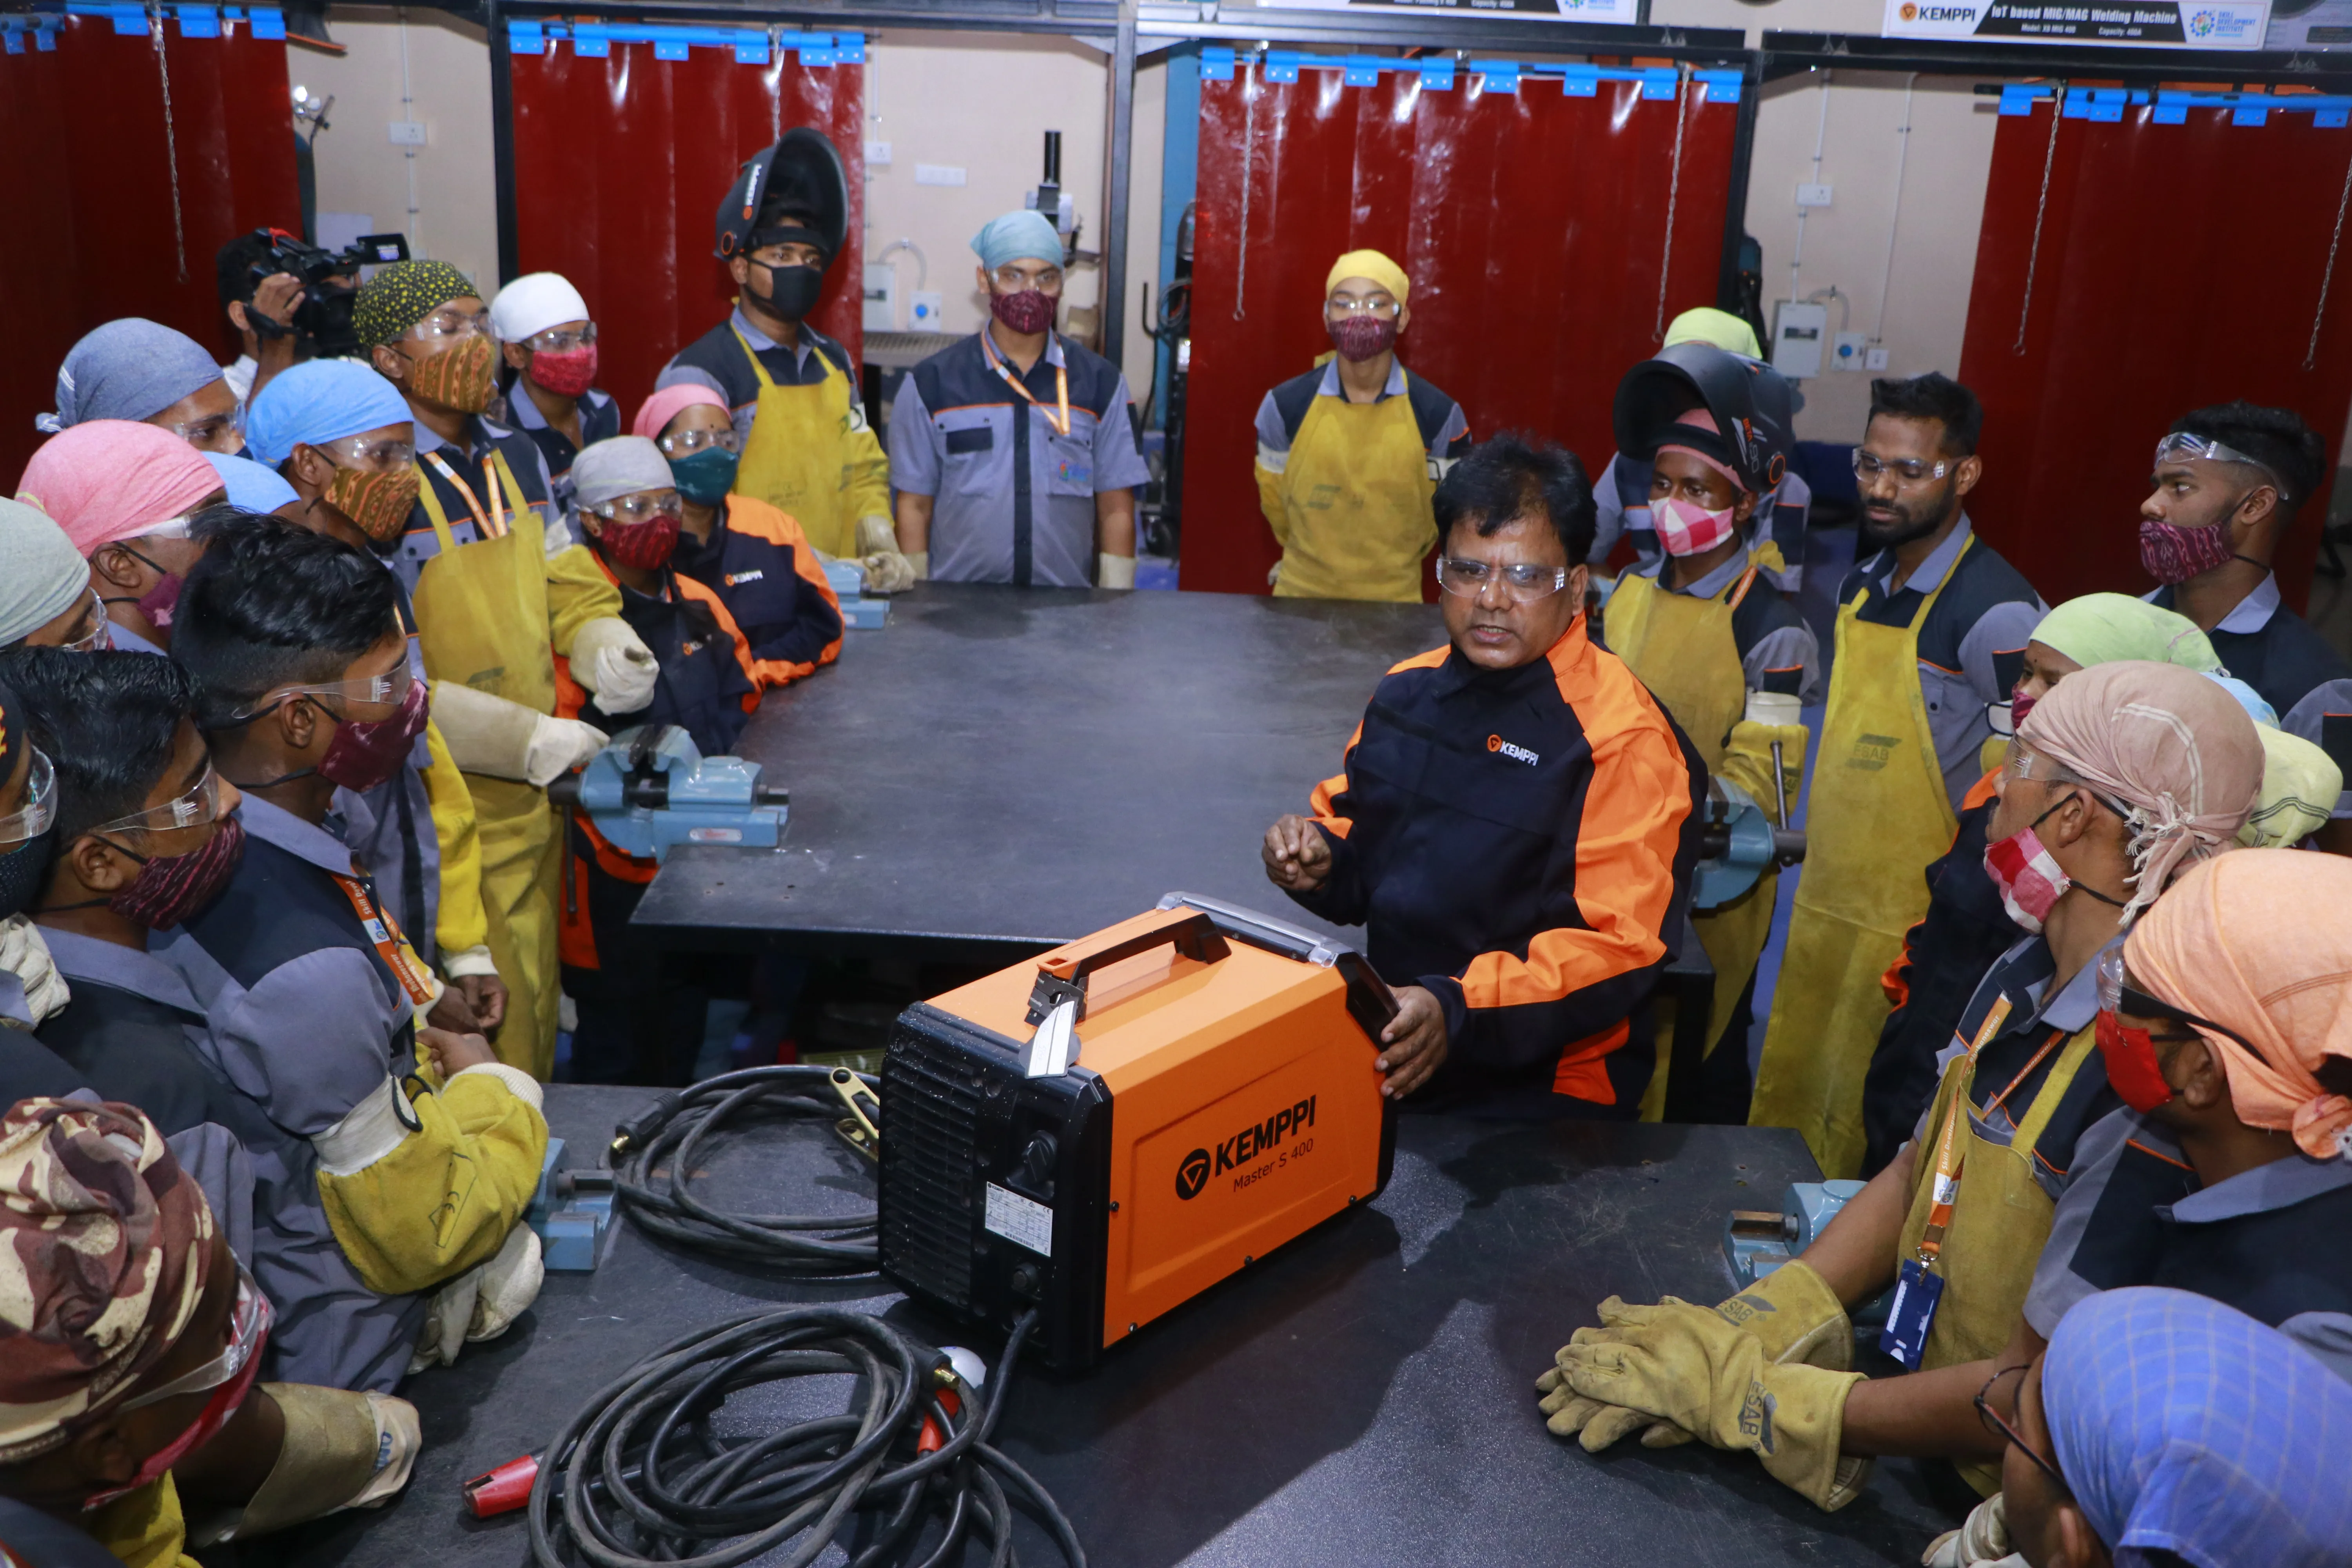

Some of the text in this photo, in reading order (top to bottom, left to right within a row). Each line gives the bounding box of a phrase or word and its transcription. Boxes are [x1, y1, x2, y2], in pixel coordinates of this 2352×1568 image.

[1919, 7, 1976, 22] KEMPPI
[1991, 5, 2177, 24] IoT based MIG/MAG Welding Machine
[1742, 417, 1753, 442] BETA
[1499, 740, 1539, 766] KEMPPI
[1854, 743, 1889, 761] ESAB
[358, 899, 372, 915] Skill
[2013, 1042, 2051, 1084] Bhubaneswar
[1215, 1094, 1316, 1178] KEMPPI
[1234, 1138, 1314, 1192] Master S 400
[1743, 1381, 1768, 1436] ESAB
